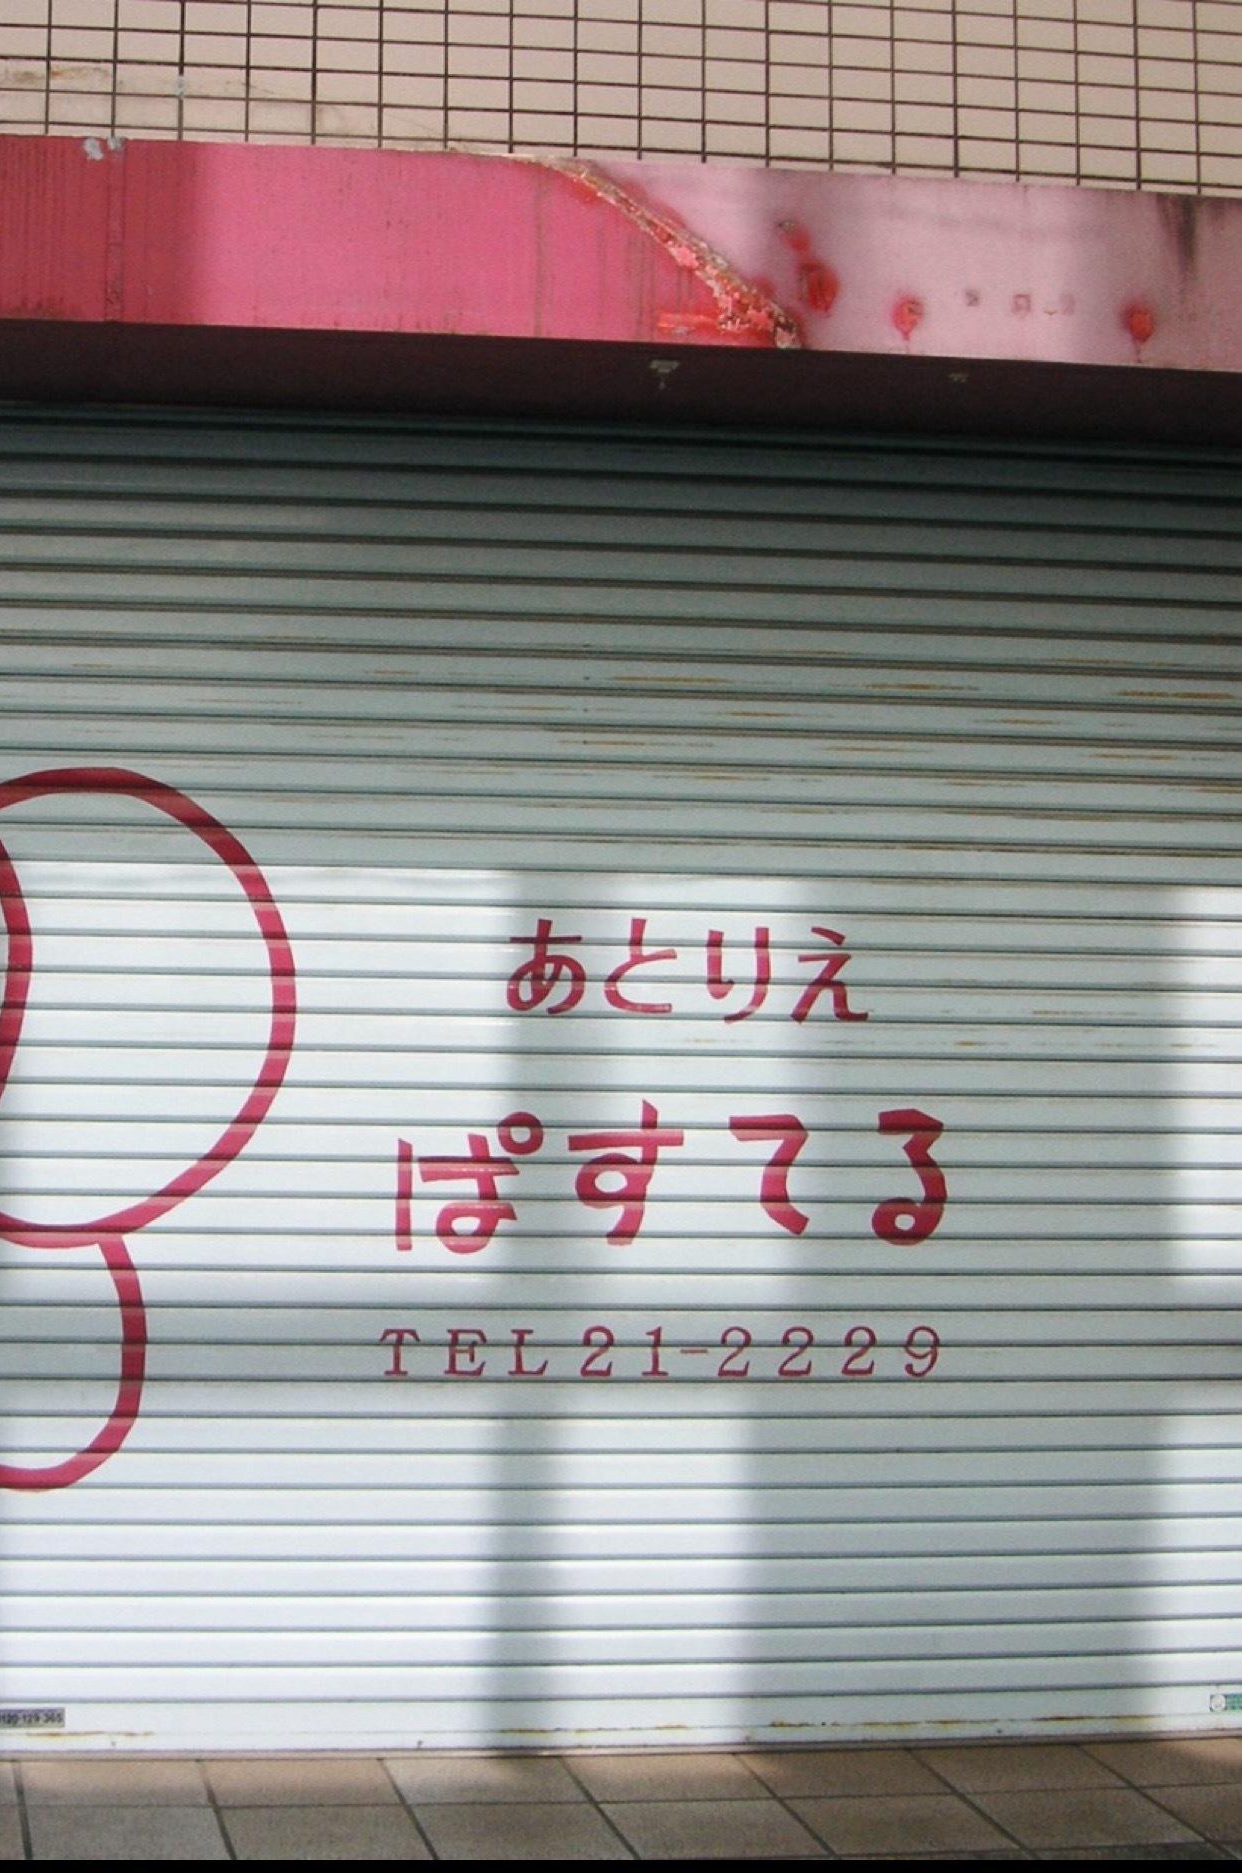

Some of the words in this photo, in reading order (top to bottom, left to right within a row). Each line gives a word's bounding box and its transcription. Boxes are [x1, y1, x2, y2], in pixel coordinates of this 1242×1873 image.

[506, 918, 868, 1023] あとりえ
[395, 1100, 949, 1255] ぱすてる
